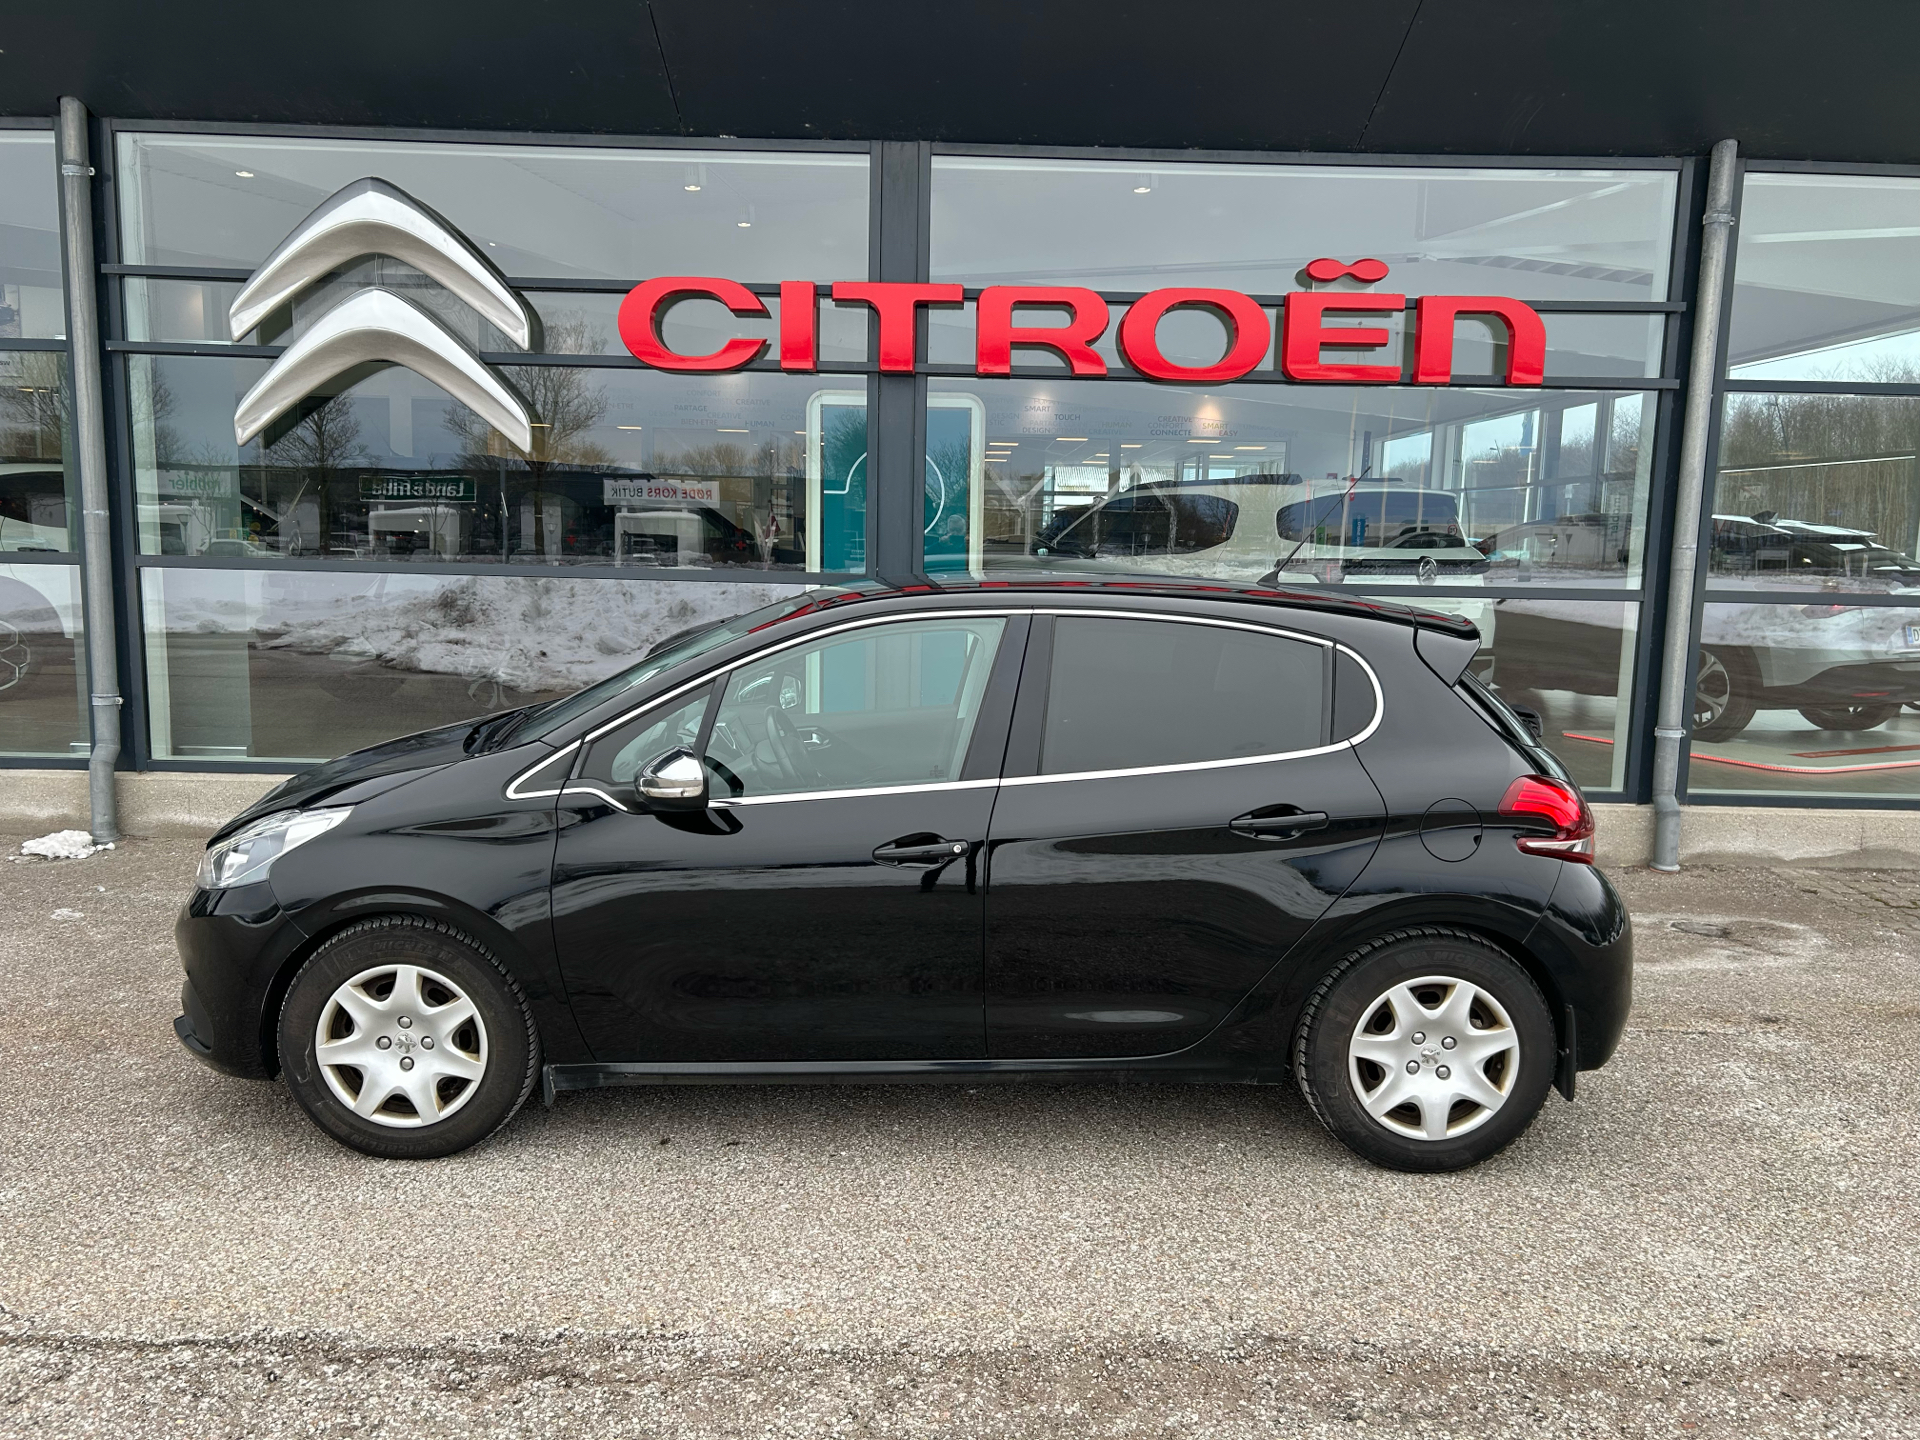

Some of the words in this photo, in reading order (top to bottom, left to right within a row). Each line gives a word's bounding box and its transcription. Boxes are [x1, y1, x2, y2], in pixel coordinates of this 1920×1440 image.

[686, 389, 721, 397] CONFORT
[735, 398, 771, 406] CREATIVE
[673, 404, 708, 413] PARTAGE
[1024, 405, 1051, 413] SMART
[706, 411, 742, 420] CREATIVE
[1054, 413, 1081, 421] TOUCH
[1157, 415, 1193, 423] CREATIVE
[744, 420, 775, 428] HUMAN
[1101, 421, 1132, 429] HUMAN
[1147, 422, 1184, 430] CONFORT
[1202, 422, 1229, 430] SMART
[1022, 426, 1051, 434] DESIGN
[1150, 429, 1192, 437] CONNECTE
[1218, 429, 1239, 437] EASY
